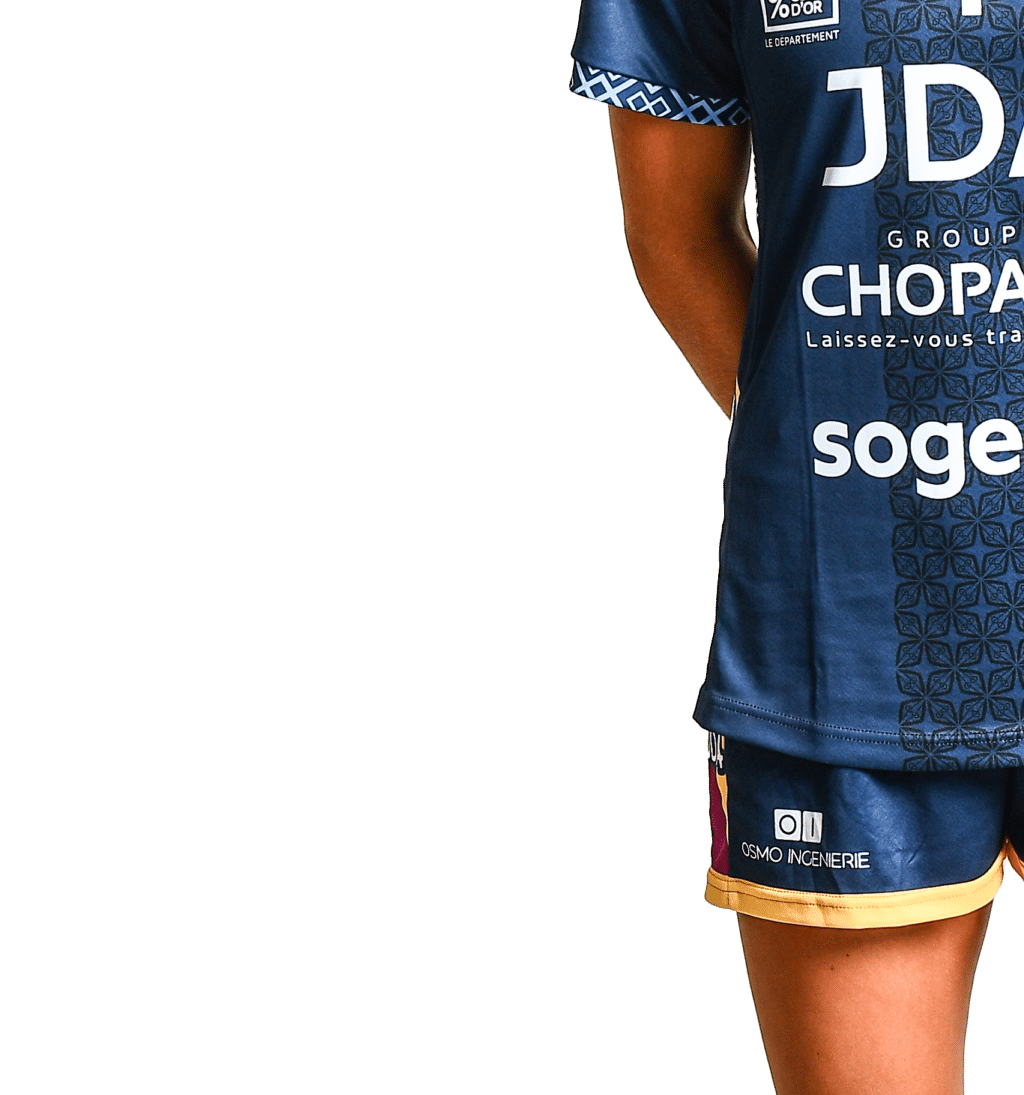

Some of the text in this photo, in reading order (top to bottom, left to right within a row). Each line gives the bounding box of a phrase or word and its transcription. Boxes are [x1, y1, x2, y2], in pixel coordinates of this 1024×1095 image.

[791, 0, 824, 17] D'OR
[764, 38, 774, 48] LE
[805, 331, 974, 349] Laissez-vous
[741, 841, 871, 869] OSMO INGENIERIE
